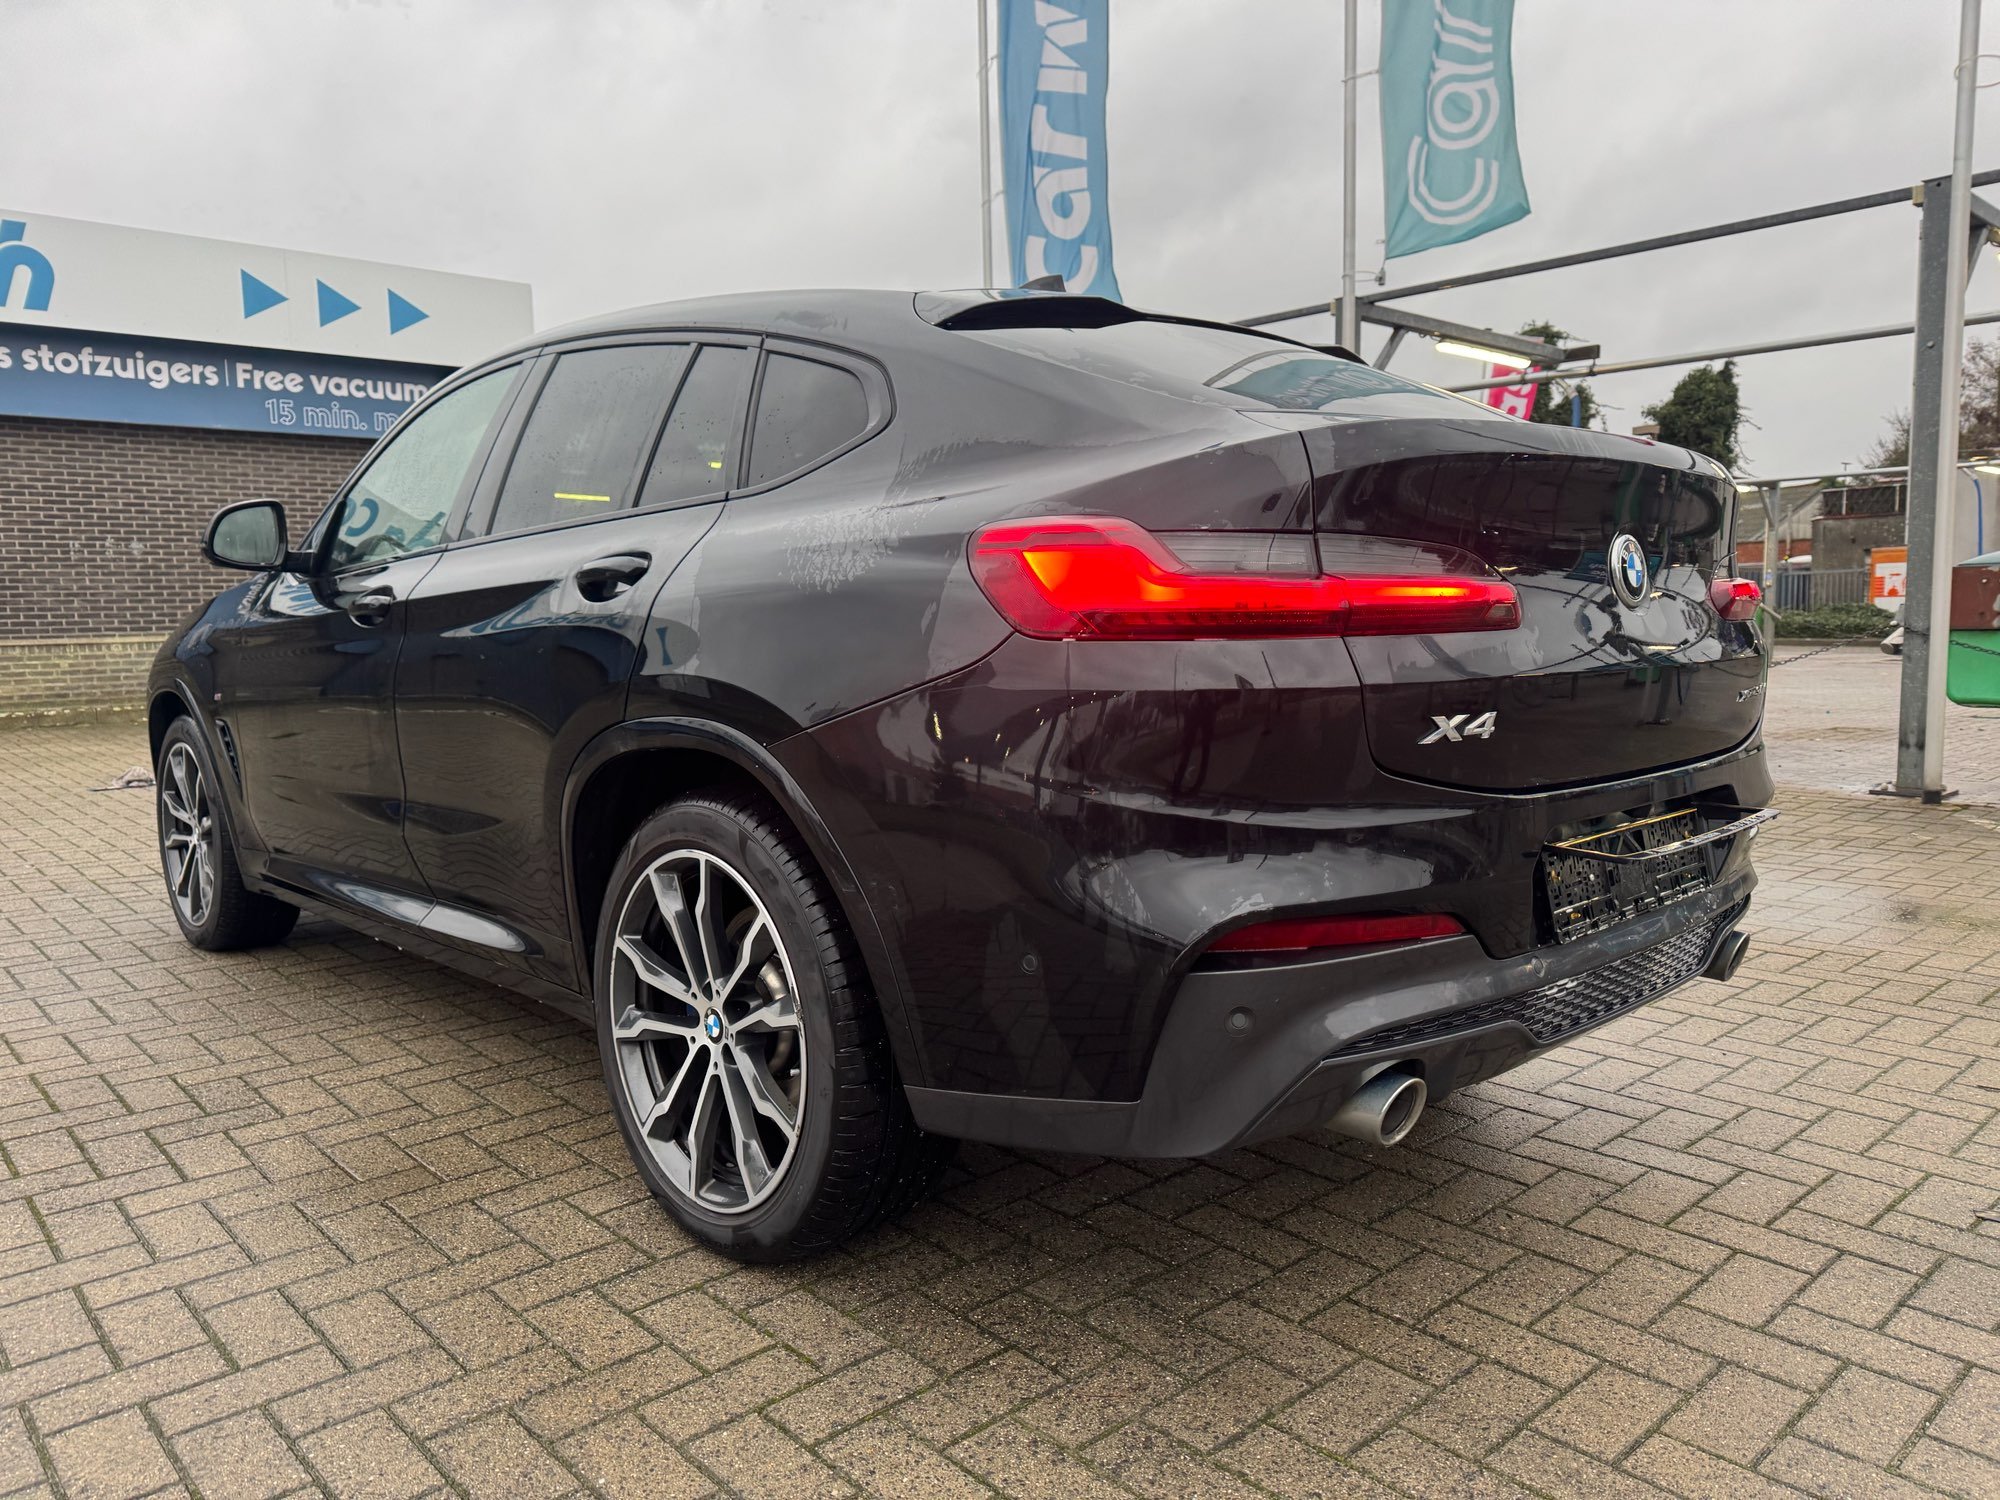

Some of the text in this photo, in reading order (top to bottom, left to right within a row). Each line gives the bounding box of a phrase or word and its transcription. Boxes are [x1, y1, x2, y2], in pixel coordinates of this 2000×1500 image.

[21, 344, 219, 389] stofzuigers
[235, 362, 304, 393] Free
[265, 398, 296, 426] 15
[303, 401, 368, 431] min.
[1417, 711, 1498, 745] X4
